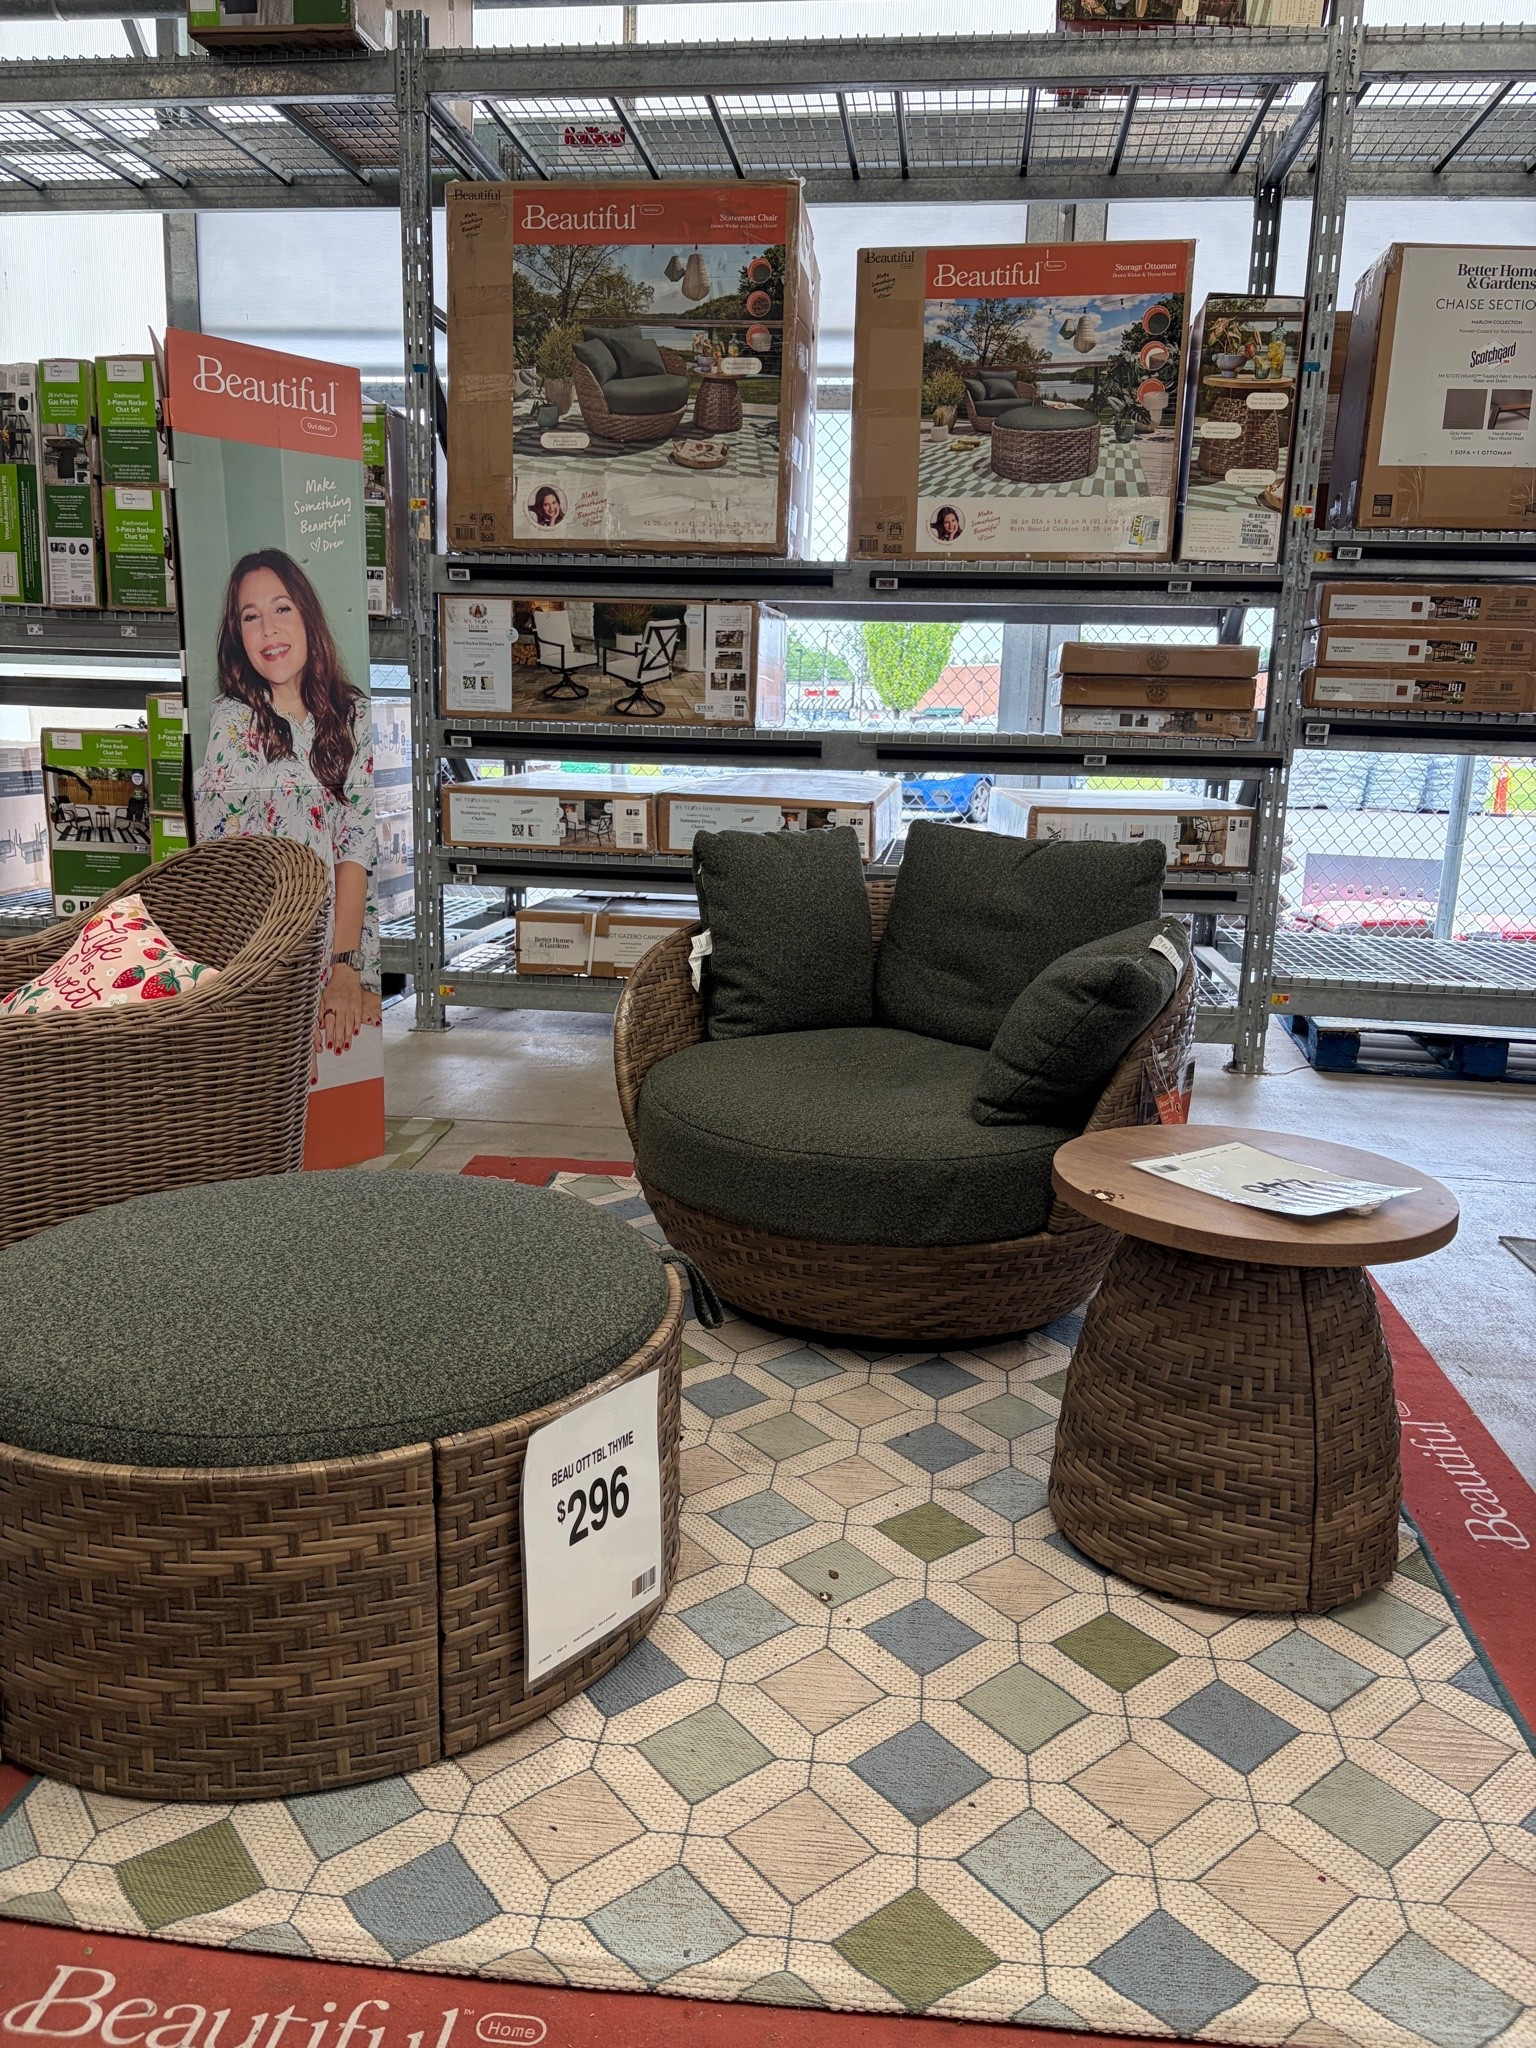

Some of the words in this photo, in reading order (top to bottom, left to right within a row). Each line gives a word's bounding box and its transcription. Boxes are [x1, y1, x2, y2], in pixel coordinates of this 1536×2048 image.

[453, 189, 500, 201] Beautiful
[521, 204, 637, 230] Beautiful
[719, 213, 756, 222] Statement
[757, 213, 778, 222] Chair
[864, 250, 915, 264] Beautiful
[1115, 263, 1143, 272] Storage
[1144, 262, 1177, 270] Ottoman
[1457, 263, 1499, 277] Better
[933, 261, 1041, 288] Beautiful
[1467, 276, 1478, 290] &
[1436, 299, 1485, 310] CHAISE
[1470, 341, 1516, 368] Scotchgard
[192, 354, 337, 416] Beautiful
[307, 422, 331, 433] Outdoor
[305, 477, 336, 494] Make
[294, 495, 352, 516] Something
[575, 498, 607, 510] Something
[300, 514, 347, 534] Beautiful
[322, 540, 344, 552] Drew
[1463, 599, 1478, 608] BH
[1460, 642, 1474, 651] BH
[1448, 683, 1462, 692] BH
[81, 919, 129, 962] Life
[534, 936, 552, 944] Better
[37, 953, 104, 1009] Sweet
[552, 1464, 574, 1488] BEAU
[575, 1454, 591, 1477] OTT
[592, 1447, 608, 1470] TBL
[607, 1430, 634, 1456] THYME
[1400, 1421, 1531, 1550] Beautiful
[557, 1465, 630, 1547] $296
[488, 2020, 535, 2041] Home
